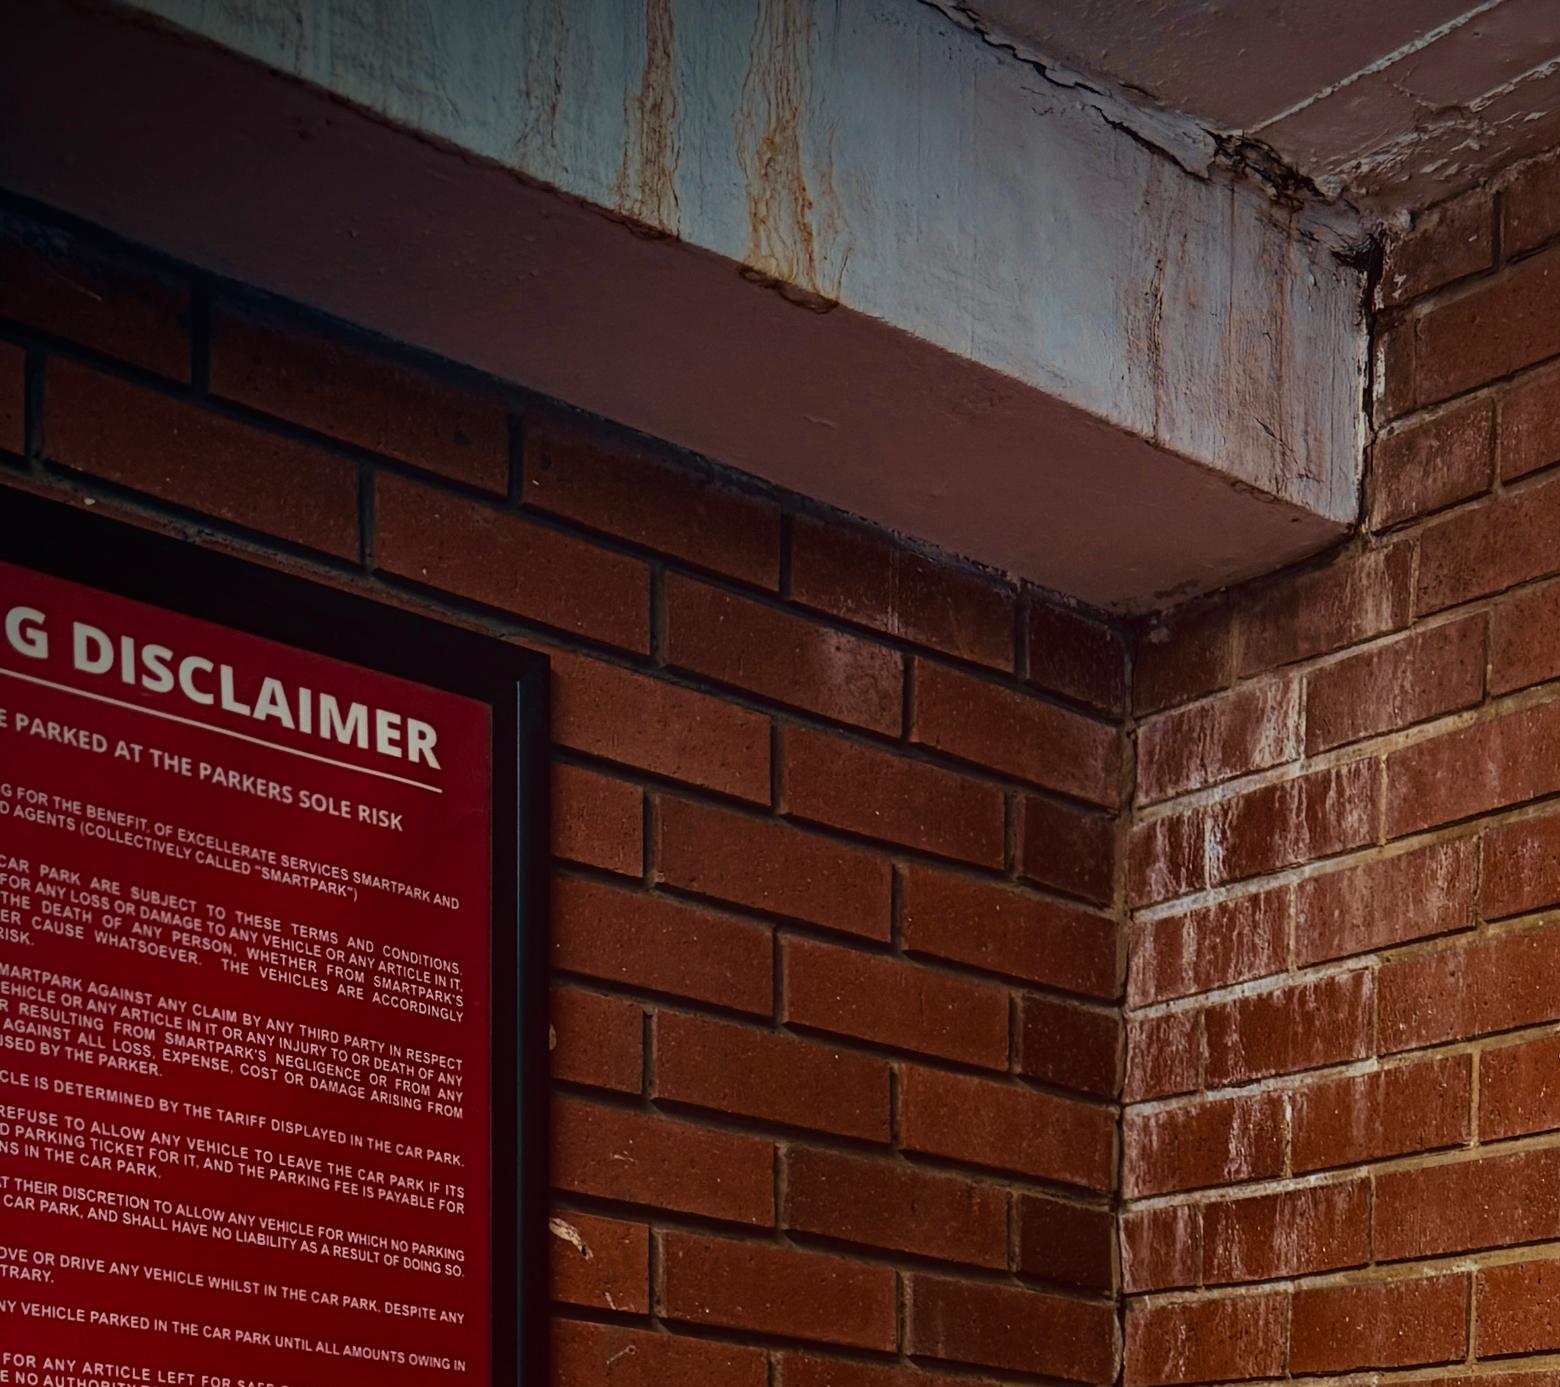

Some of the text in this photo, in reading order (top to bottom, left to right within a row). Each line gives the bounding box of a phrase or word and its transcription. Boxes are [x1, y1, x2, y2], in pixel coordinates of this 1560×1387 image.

[73, 622, 441, 770] DISCLAIMER
[16, 713, 403, 832] PARKED AT THE PARKERS SOLE RISK
[17, 787, 48, 806] FOR
[53, 796, 82, 815] THE
[154, 822, 173, 837] OF
[178, 828, 277, 865] EXCELLERATE
[281, 854, 349, 881] SERVICES
[353, 871, 430, 902] SMARTPARK
[433, 893, 459, 910] AND
[40, 864, 80, 886] PARK
[90, 877, 120, 896] ARE
[131, 886, 197, 912] SUBJECT
[206, 904, 226, 920] TO
[235, 910, 281, 932] THESE
[291, 923, 338, 945] TERMS
[347, 936, 374, 953] AND
[3, 1018, 71, 1041] AGAINST
[77, 1032, 106, 1049] ALL
[240, 1063, 278, 1081] COST
[284, 1071, 304, 1086] OR
[310, 1076, 365, 1099] DAMAGE
[370, 1090, 422, 1111] ARISING
[428, 1101, 463, 1119] FROM
[19, 1002, 463, 1103] RESULTING FROM SMARTPARK'S NEGLIGENCE OR FROM ANY
[40, 1041, 60, 1057] BY
[65, 1046, 94, 1064] THE
[35, 1076, 49, 1090] IS
[54, 1079, 154, 1109] DETERMINED
[159, 1098, 179, 1113] BY
[183, 1103, 212, 1120] THE
[216, 1108, 266, 1128] TARIFF
[271, 1118, 346, 1144] DISPLAYED
[350, 1134, 363, 1148] IN
[367, 1137, 391, 1153] THE
[396, 1143, 423, 1159] CAR
[64, 1116, 85, 1131] TO
[90, 1121, 145, 1141] ALLOW
[150, 1131, 181, 1147] ANY
[186, 1137, 248, 1160] VEHICLE
[254, 1149, 273, 1163] TO
[279, 1153, 322, 1173] LEAVE
[327, 1162, 352, 1178] THE
[358, 1168, 384, 1184] CAR
[390, 1174, 424, 1192] PARK
[429, 1181, 440, 1193] IF
[445, 1184, 464, 1199] ITS
[3, 1194, 35, 1211] CAR
[87, 1207, 118, 1223] AND
[123, 1212, 168, 1231] SHALL
[172, 1219, 208, 1237] HAVE
[212, 1226, 232, 1240] NO
[236, 1230, 297, 1250] LIABILITY
[300, 1240, 318, 1254] AS
[321, 1243, 330, 1256] A
[333, 1245, 380, 1263] RESULT
[384, 1253, 399, 1266] OF
[403, 1256, 441, 1274] DOING
[3, 1352, 36, 1368] FOR
[43, 1357, 76, 1372] ANY
[82, 1361, 150, 1381] ARTICLE
[158, 1370, 195, 1386] LEFT
[15, 1371, 38, 1386] NO
[21, 1302, 465, 1372] VEHICLE PARKED IN THE CAR PARK UNTIL ALL AMOUNTS OWING IN
